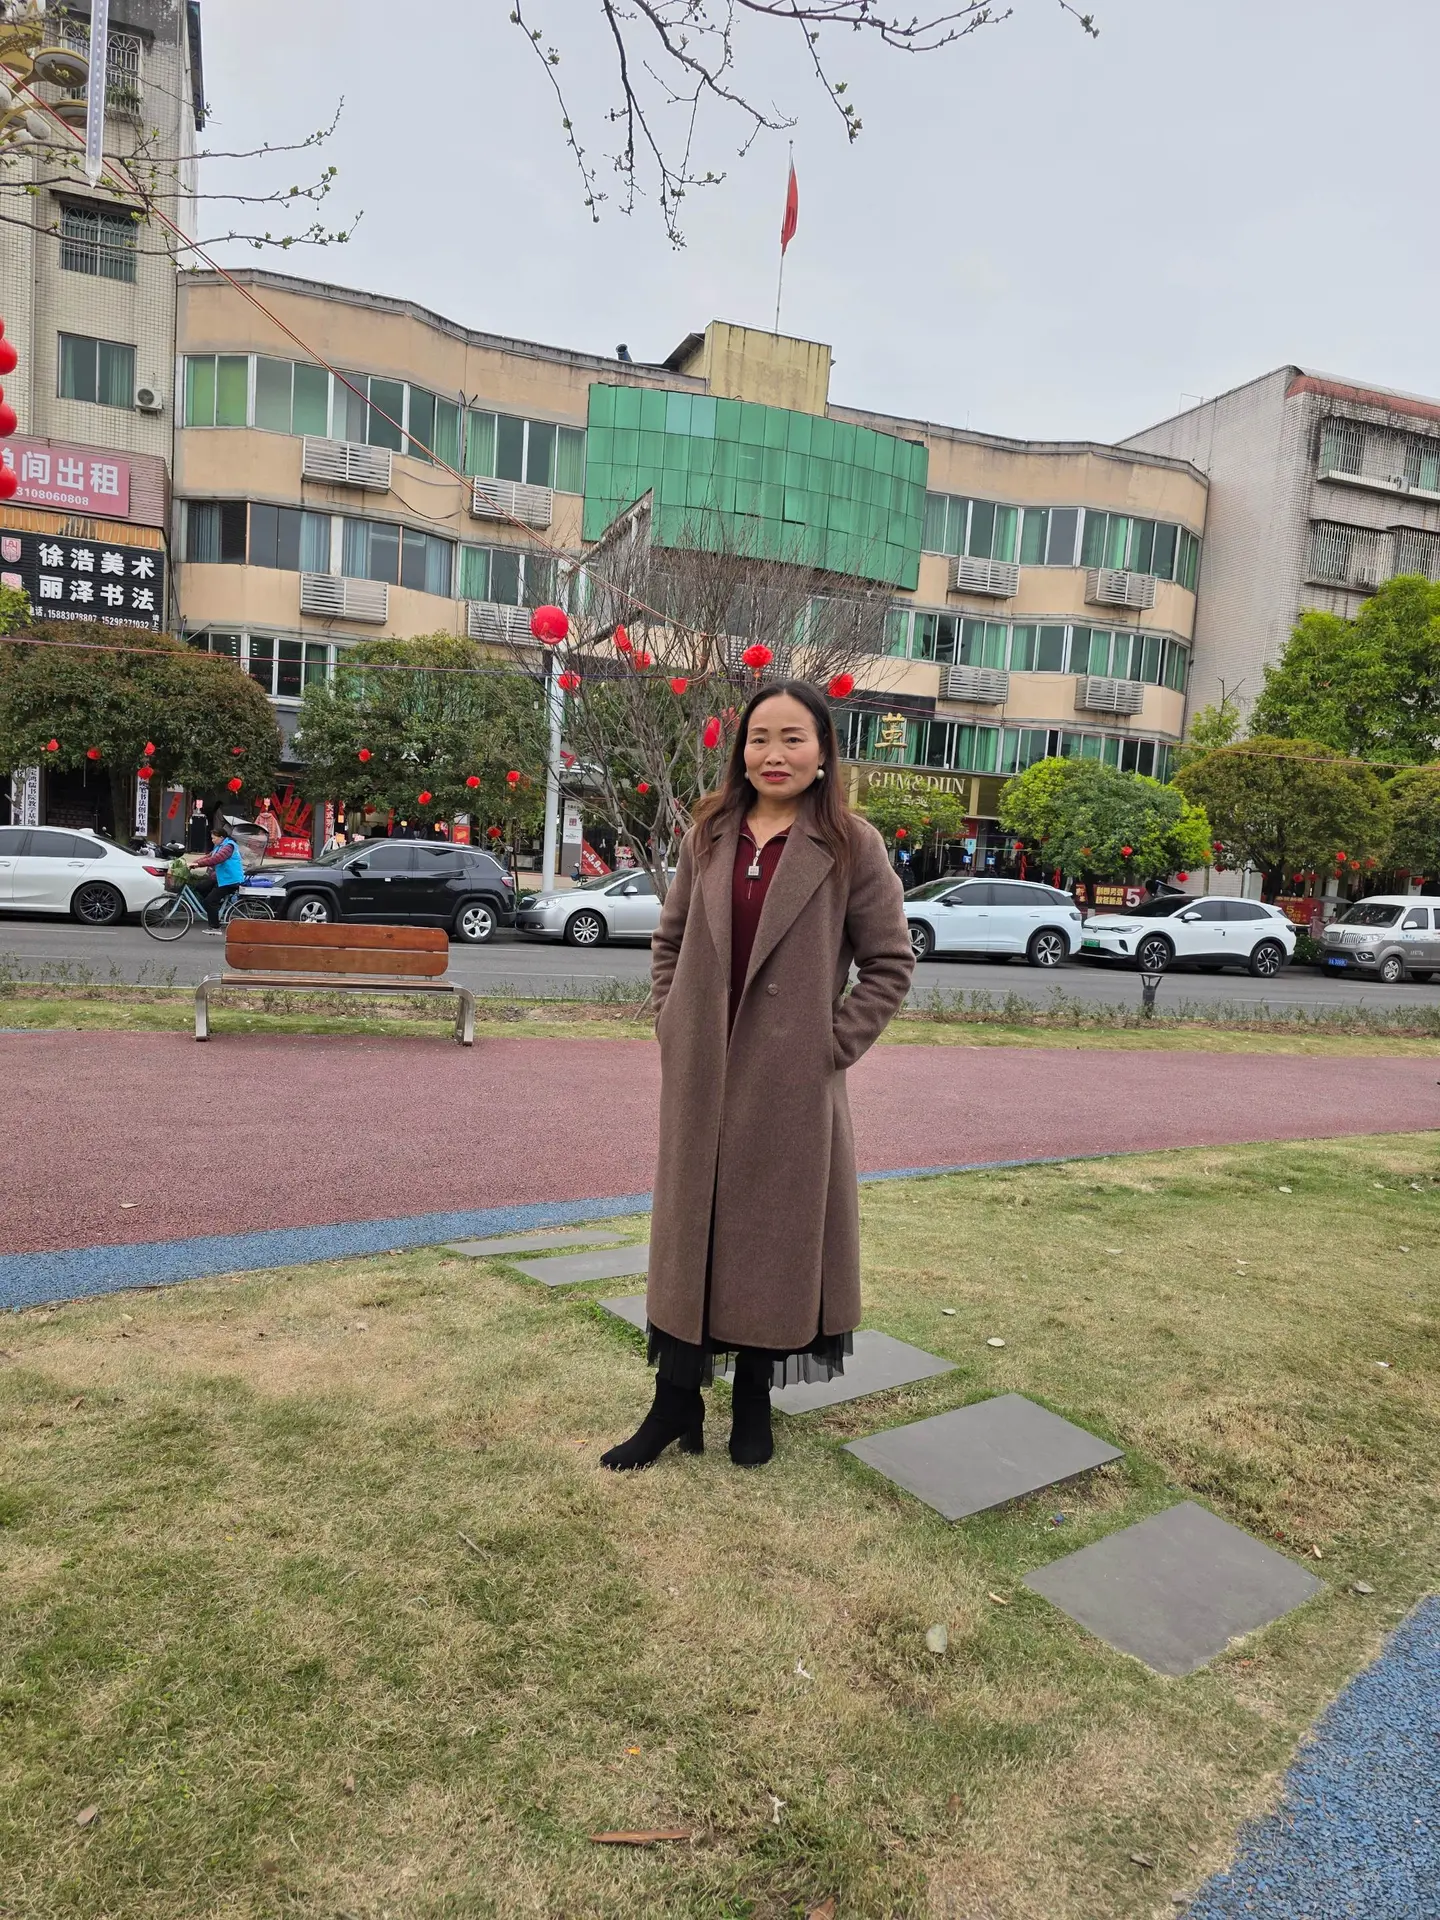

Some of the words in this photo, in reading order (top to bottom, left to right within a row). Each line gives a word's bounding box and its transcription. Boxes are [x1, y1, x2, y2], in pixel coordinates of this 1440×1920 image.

[38, 542, 155, 580] 徐浩美术
[38, 574, 154, 611] 丽泽书法
[1125, 888, 1140, 908] 5
